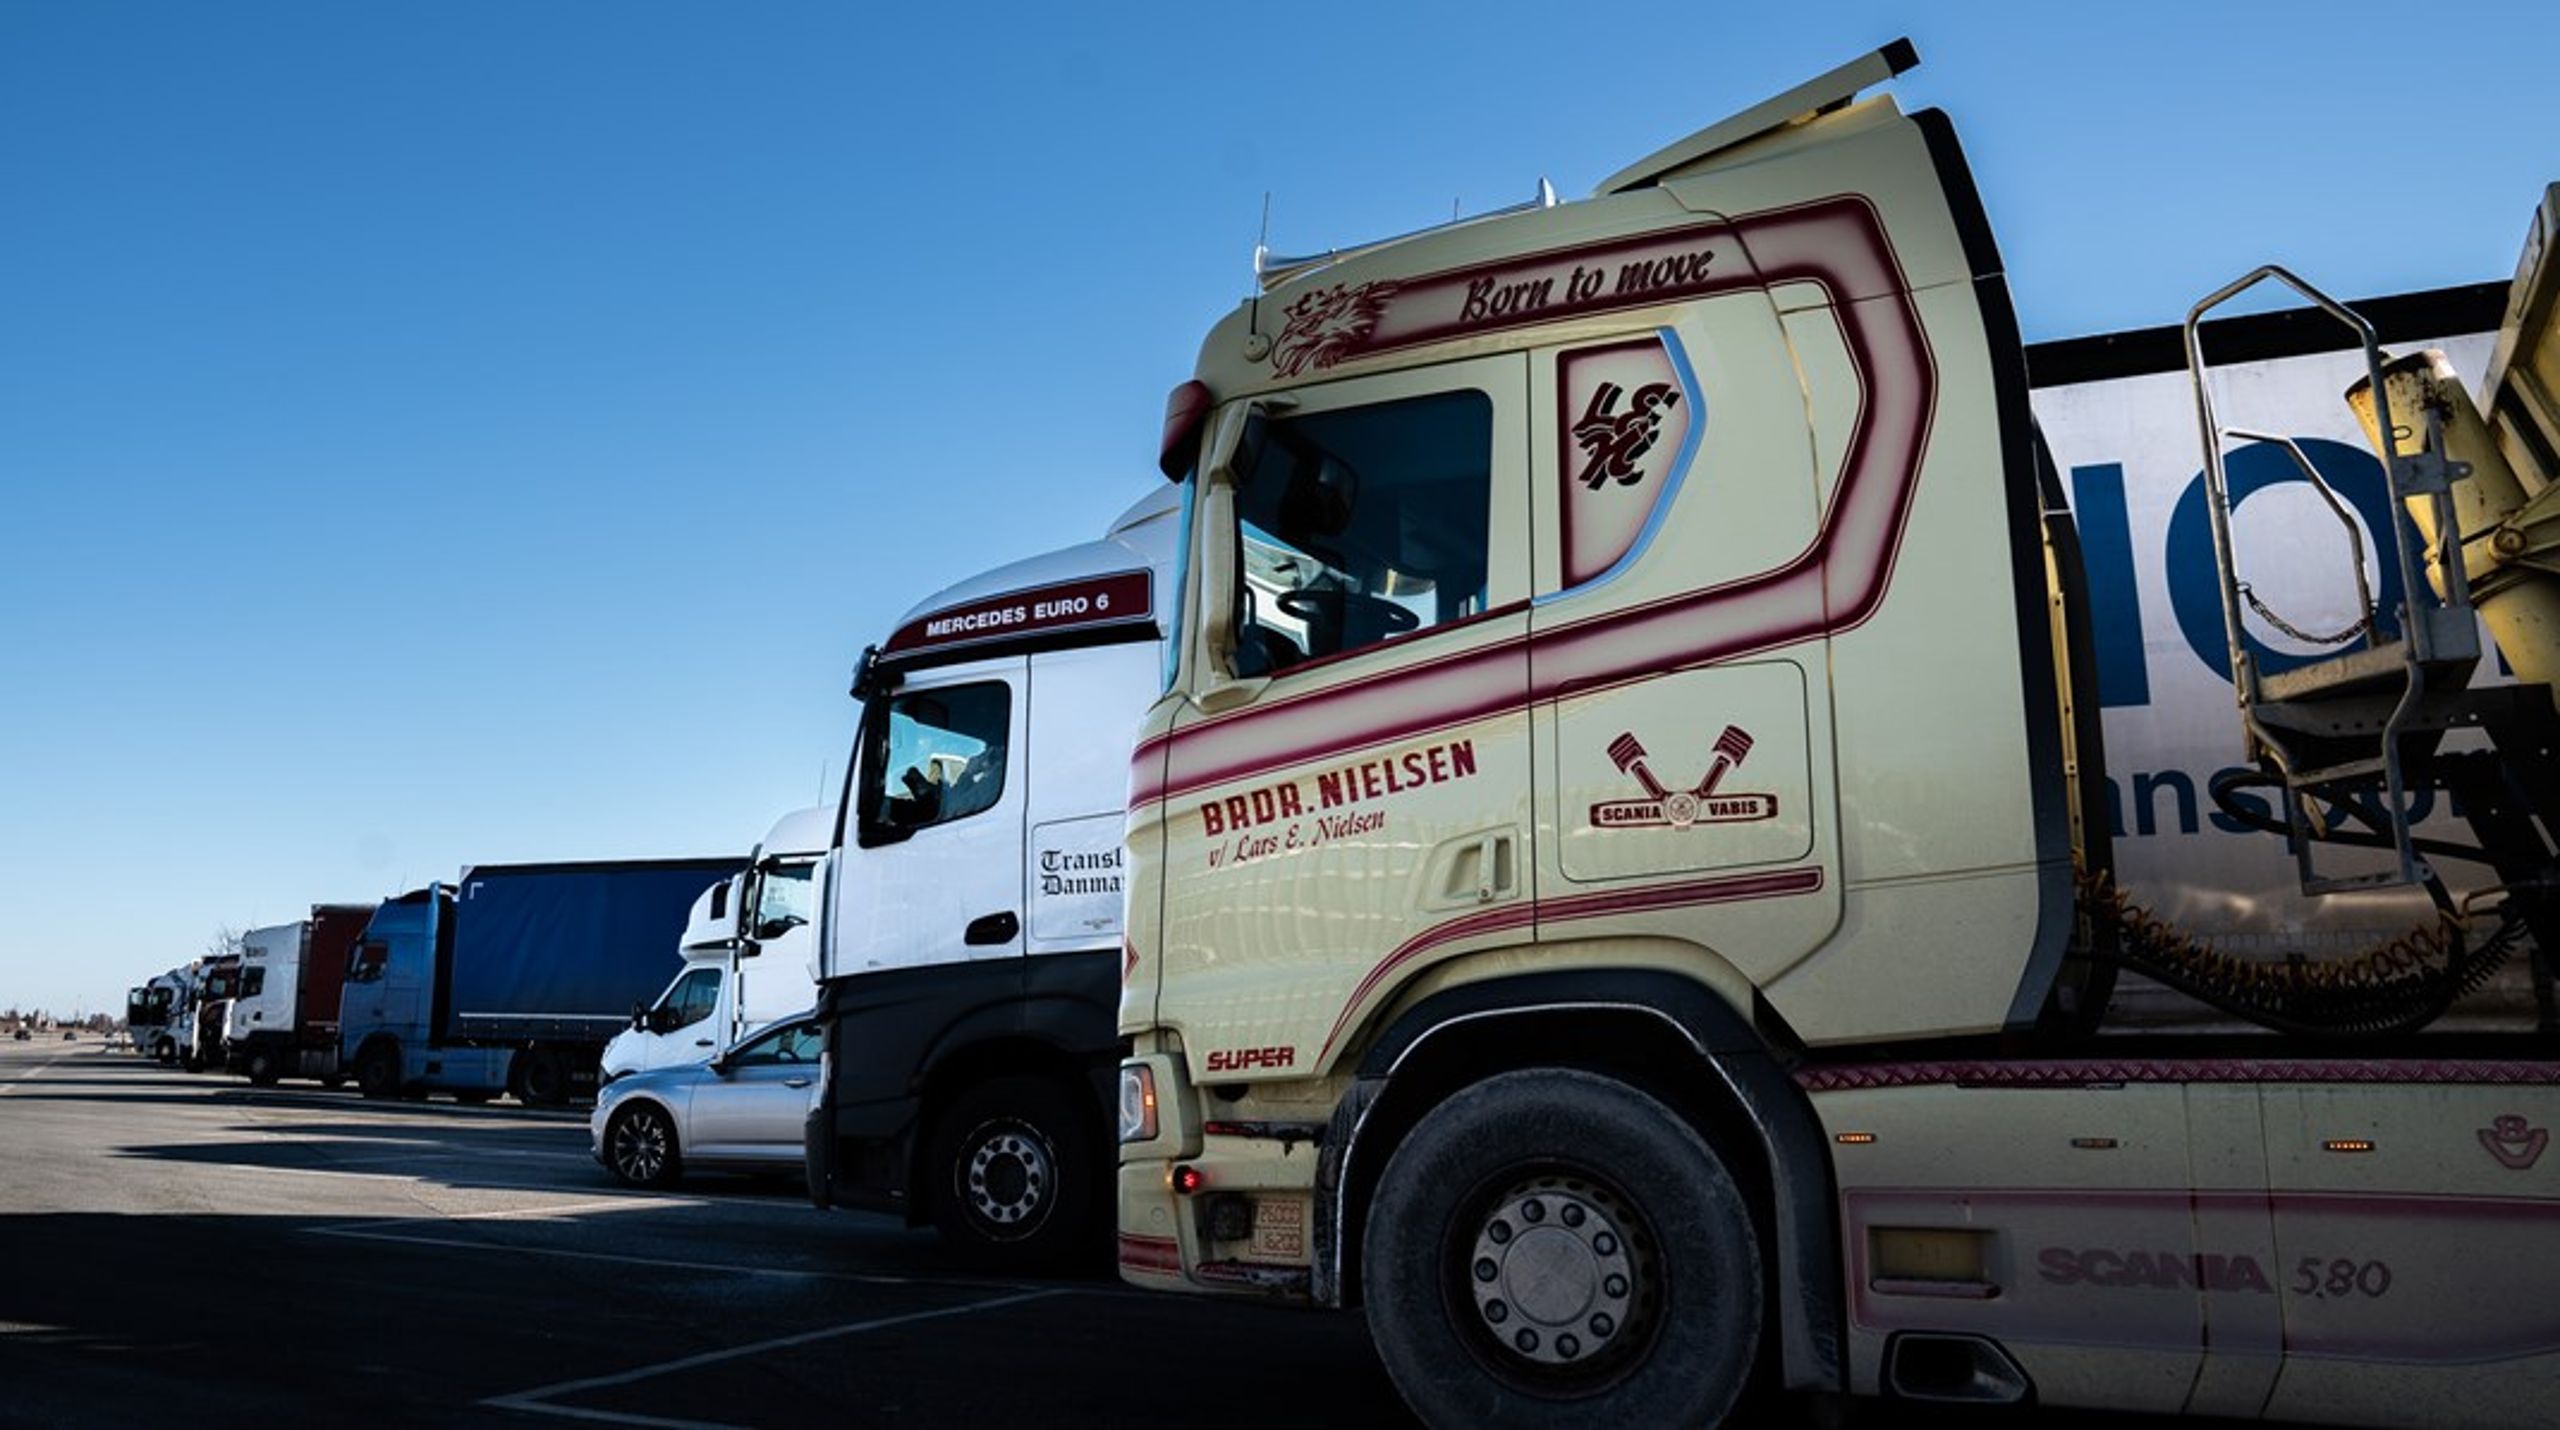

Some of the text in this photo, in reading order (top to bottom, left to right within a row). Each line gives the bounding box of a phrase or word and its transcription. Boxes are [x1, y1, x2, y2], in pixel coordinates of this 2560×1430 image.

[1459, 250, 1714, 322] Born to move
[926, 593, 1110, 637] MERCEDES EURO 6
[1603, 800, 1759, 821] SCANIA VABIS
[1233, 834, 1279, 863] Lars
[1285, 823, 1305, 850] E.
[1311, 809, 1386, 847] Nielsen
[1041, 874, 1125, 896] Danma
[1207, 1046, 1295, 1072] SUPER
[2038, 1247, 2274, 1294] SCANIA
